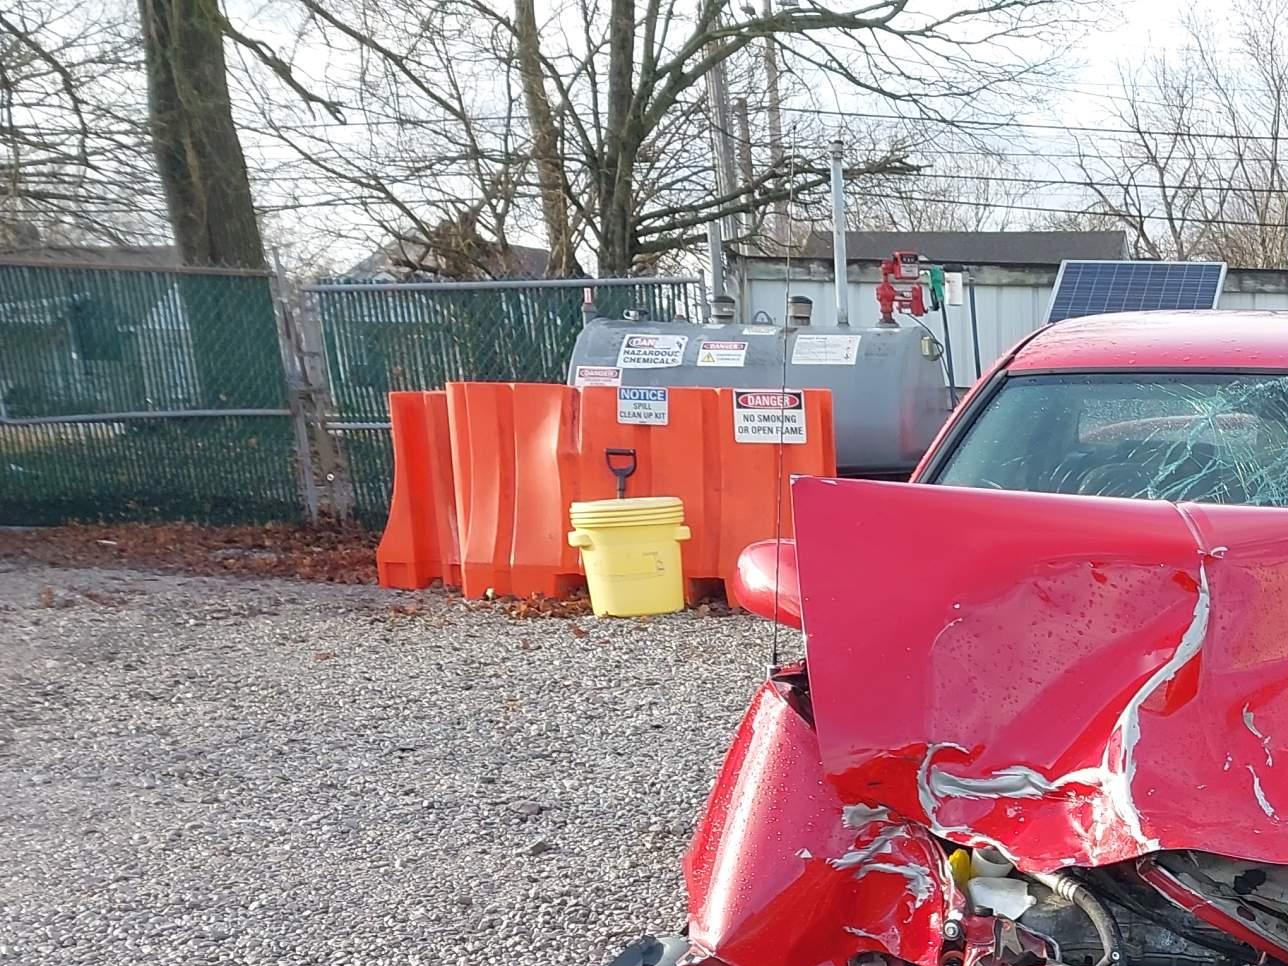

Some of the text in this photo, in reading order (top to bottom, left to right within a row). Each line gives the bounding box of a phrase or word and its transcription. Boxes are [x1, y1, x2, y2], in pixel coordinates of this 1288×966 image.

[622, 356, 680, 365] CHEMICALS
[621, 389, 665, 401] NOTICE
[747, 395, 790, 407] DANGER
[633, 402, 652, 410] SPILL
[619, 411, 666, 420] CLEAN UP KIT
[743, 414, 797, 424] NO SMOKNG
[738, 427, 750, 435] OR
[751, 427, 774, 435] OPEN
